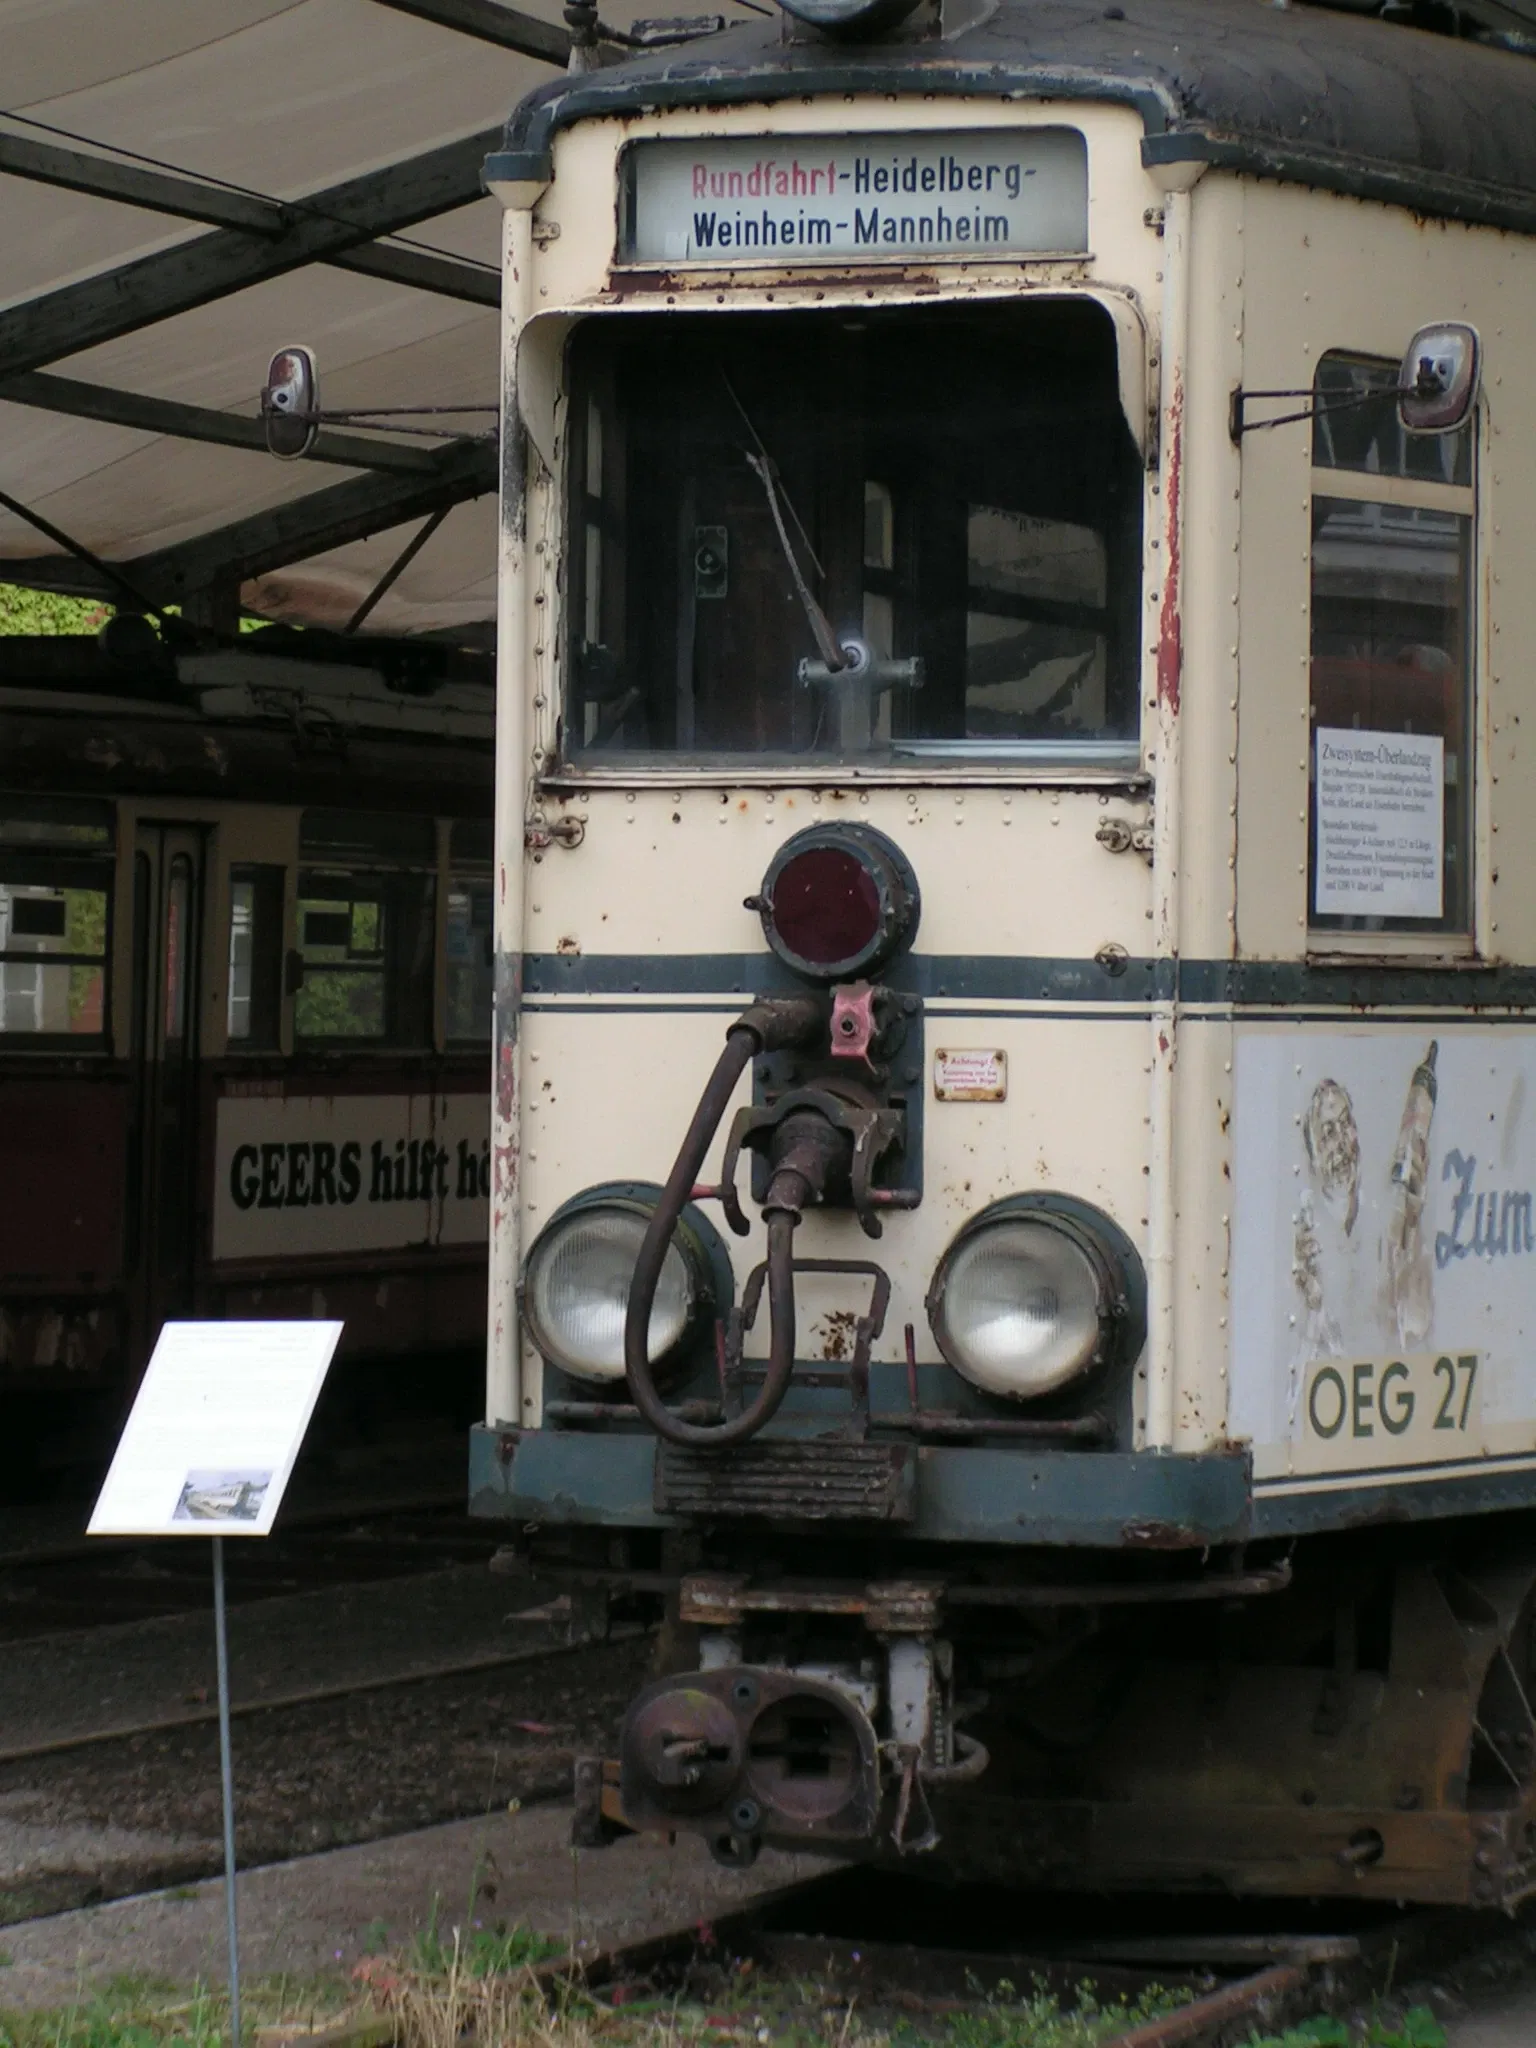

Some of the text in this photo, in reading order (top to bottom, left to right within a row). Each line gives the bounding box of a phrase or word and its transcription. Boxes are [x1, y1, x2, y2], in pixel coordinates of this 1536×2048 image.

[230, 1141, 361, 1210] GEERS
[368, 1138, 449, 1202] hilft
[1435, 1148, 1535, 1269] Zum
[1309, 1355, 1478, 1439] OEG 27
